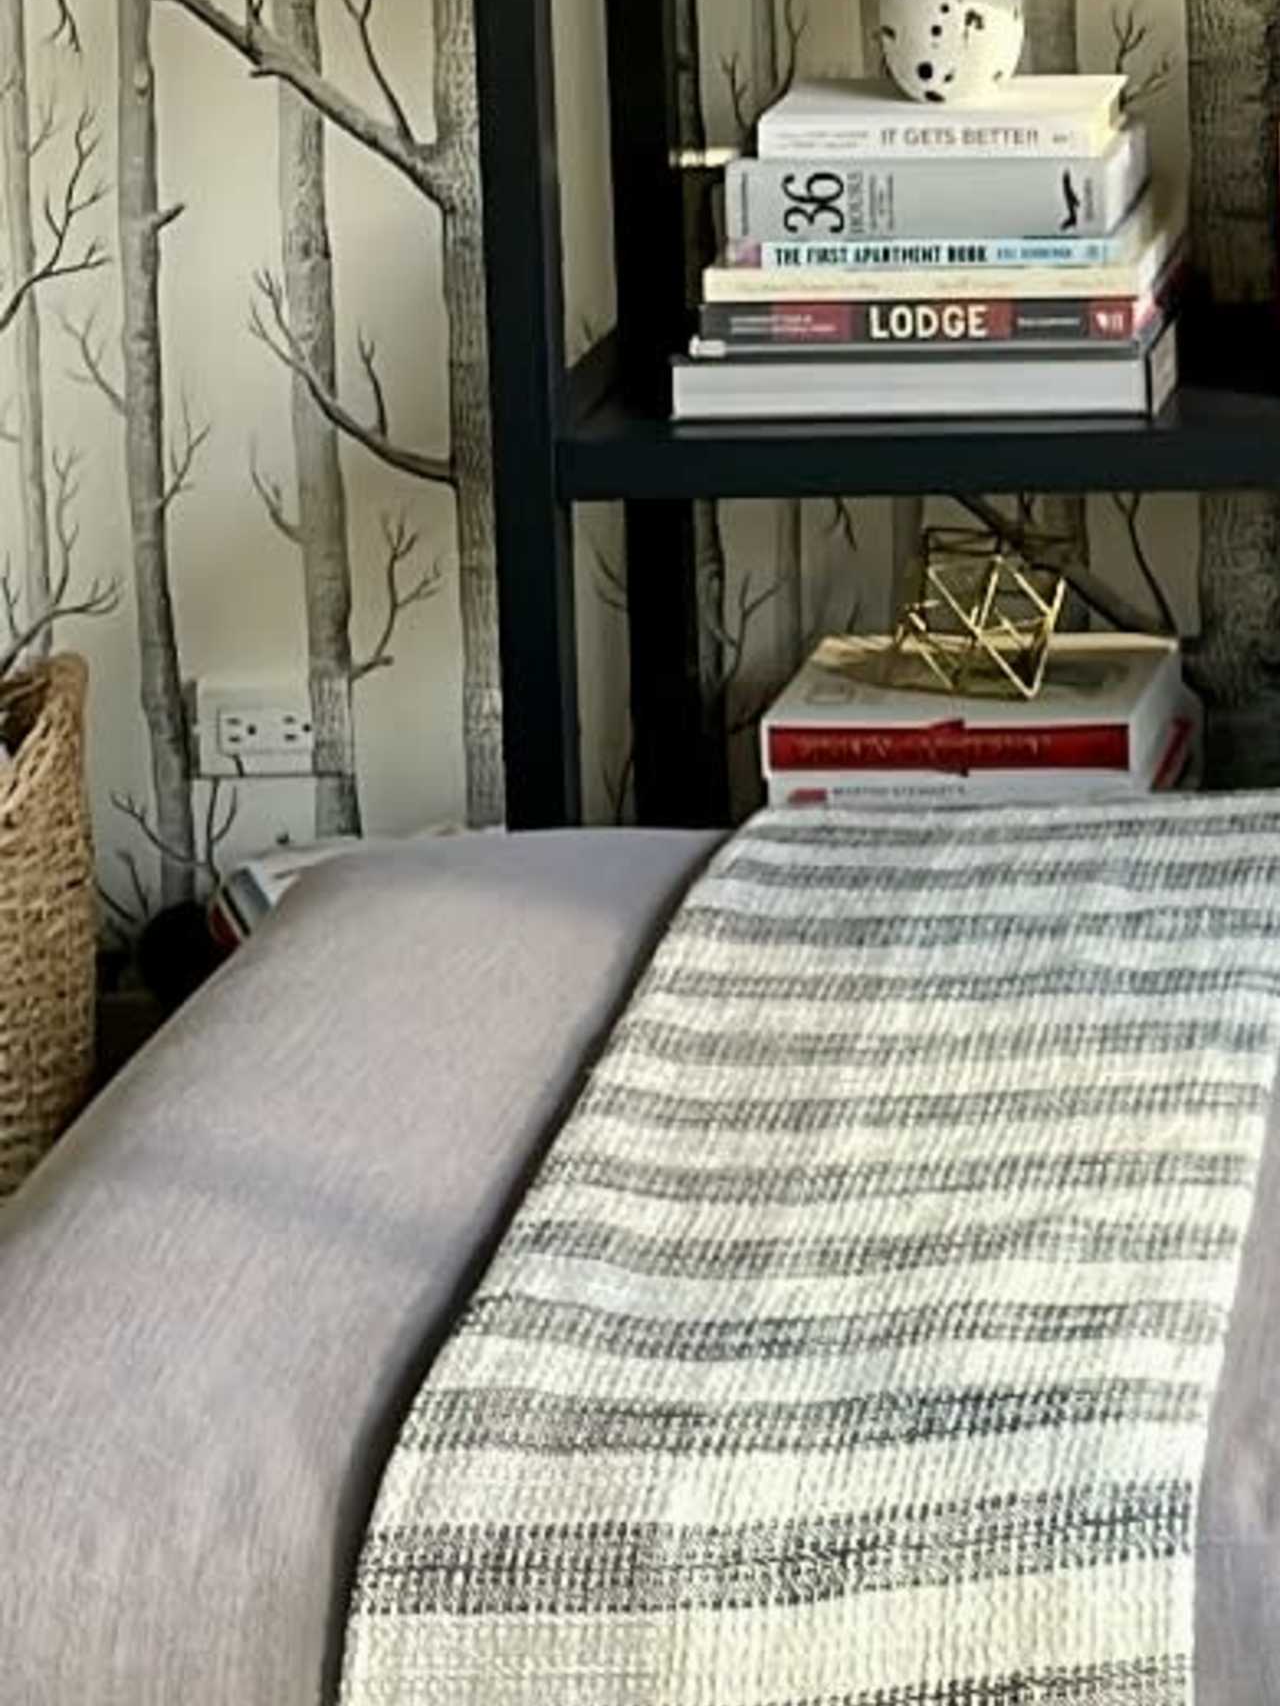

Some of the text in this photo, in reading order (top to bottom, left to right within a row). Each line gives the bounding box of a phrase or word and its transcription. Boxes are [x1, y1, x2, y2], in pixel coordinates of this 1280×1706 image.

[903, 129, 956, 146] GETS
[781, 171, 845, 235] 36
[775, 248, 800, 265] THE
[807, 247, 848, 264] FIRST
[852, 246, 941, 263] APARTMENT
[869, 305, 988, 339] LODGE
